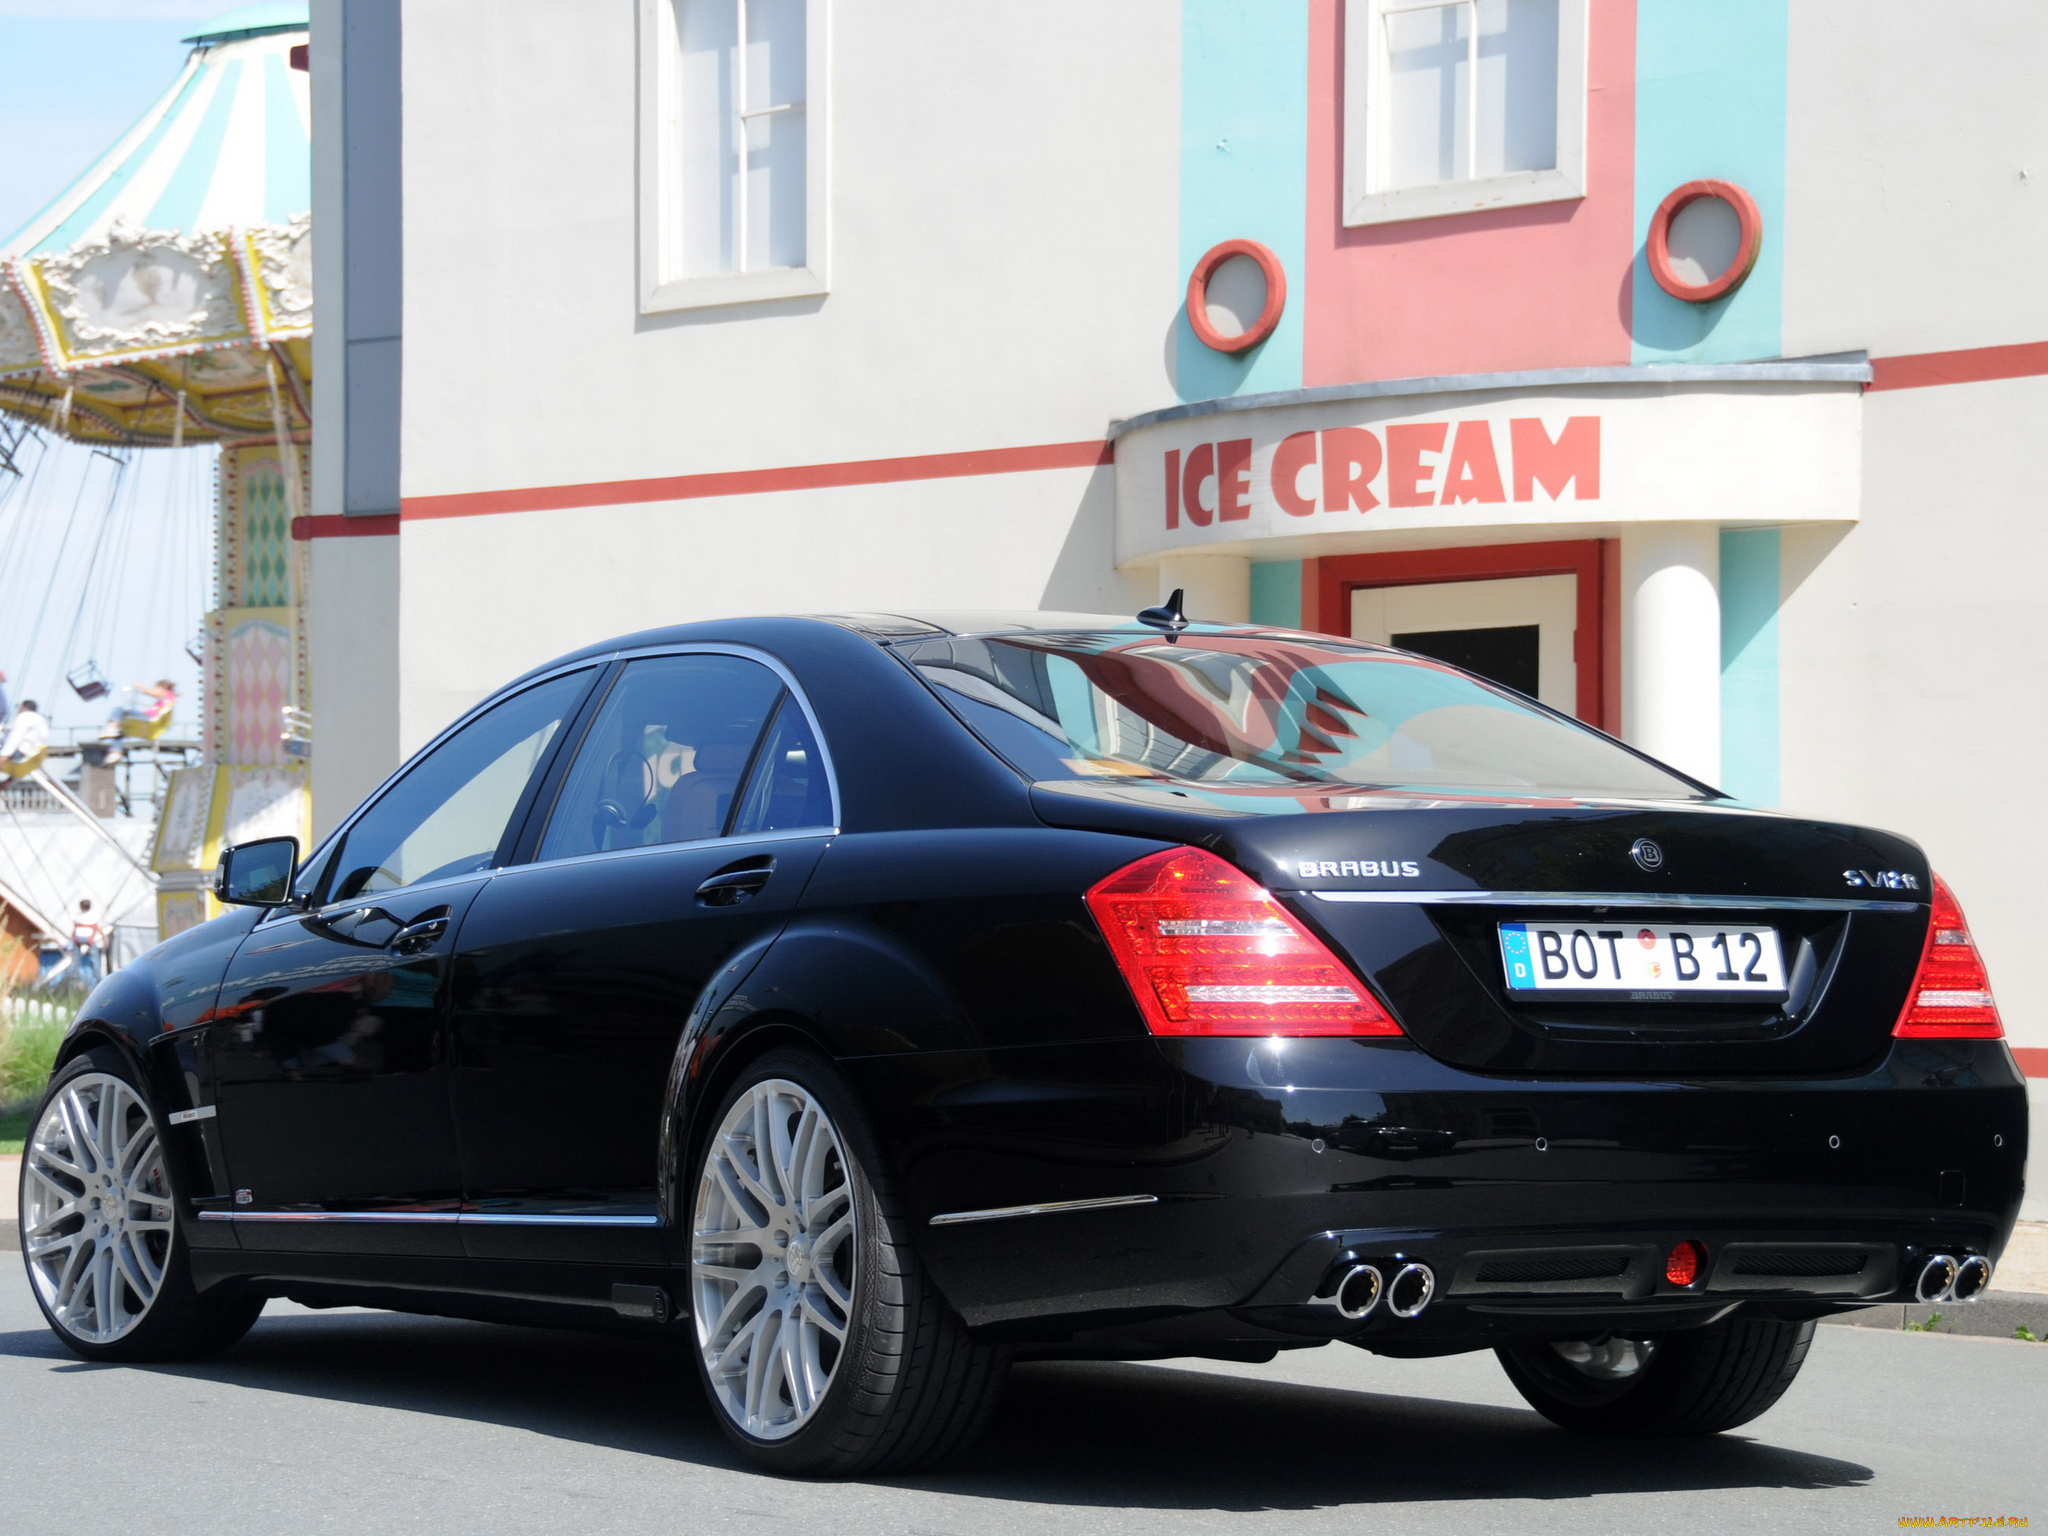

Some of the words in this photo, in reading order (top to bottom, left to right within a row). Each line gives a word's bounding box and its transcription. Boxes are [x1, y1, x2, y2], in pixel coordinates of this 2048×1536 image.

[1164, 438, 1252, 531] ICE
[1271, 416, 1601, 517] CREAM
[1298, 860, 1420, 877] BRABUS
[1537, 929, 1624, 980] BOT
[1670, 932, 1701, 981] B
[1712, 932, 1768, 982] 12
[1514, 962, 1526, 978] D
[1630, 991, 1674, 1000] BRABUS
